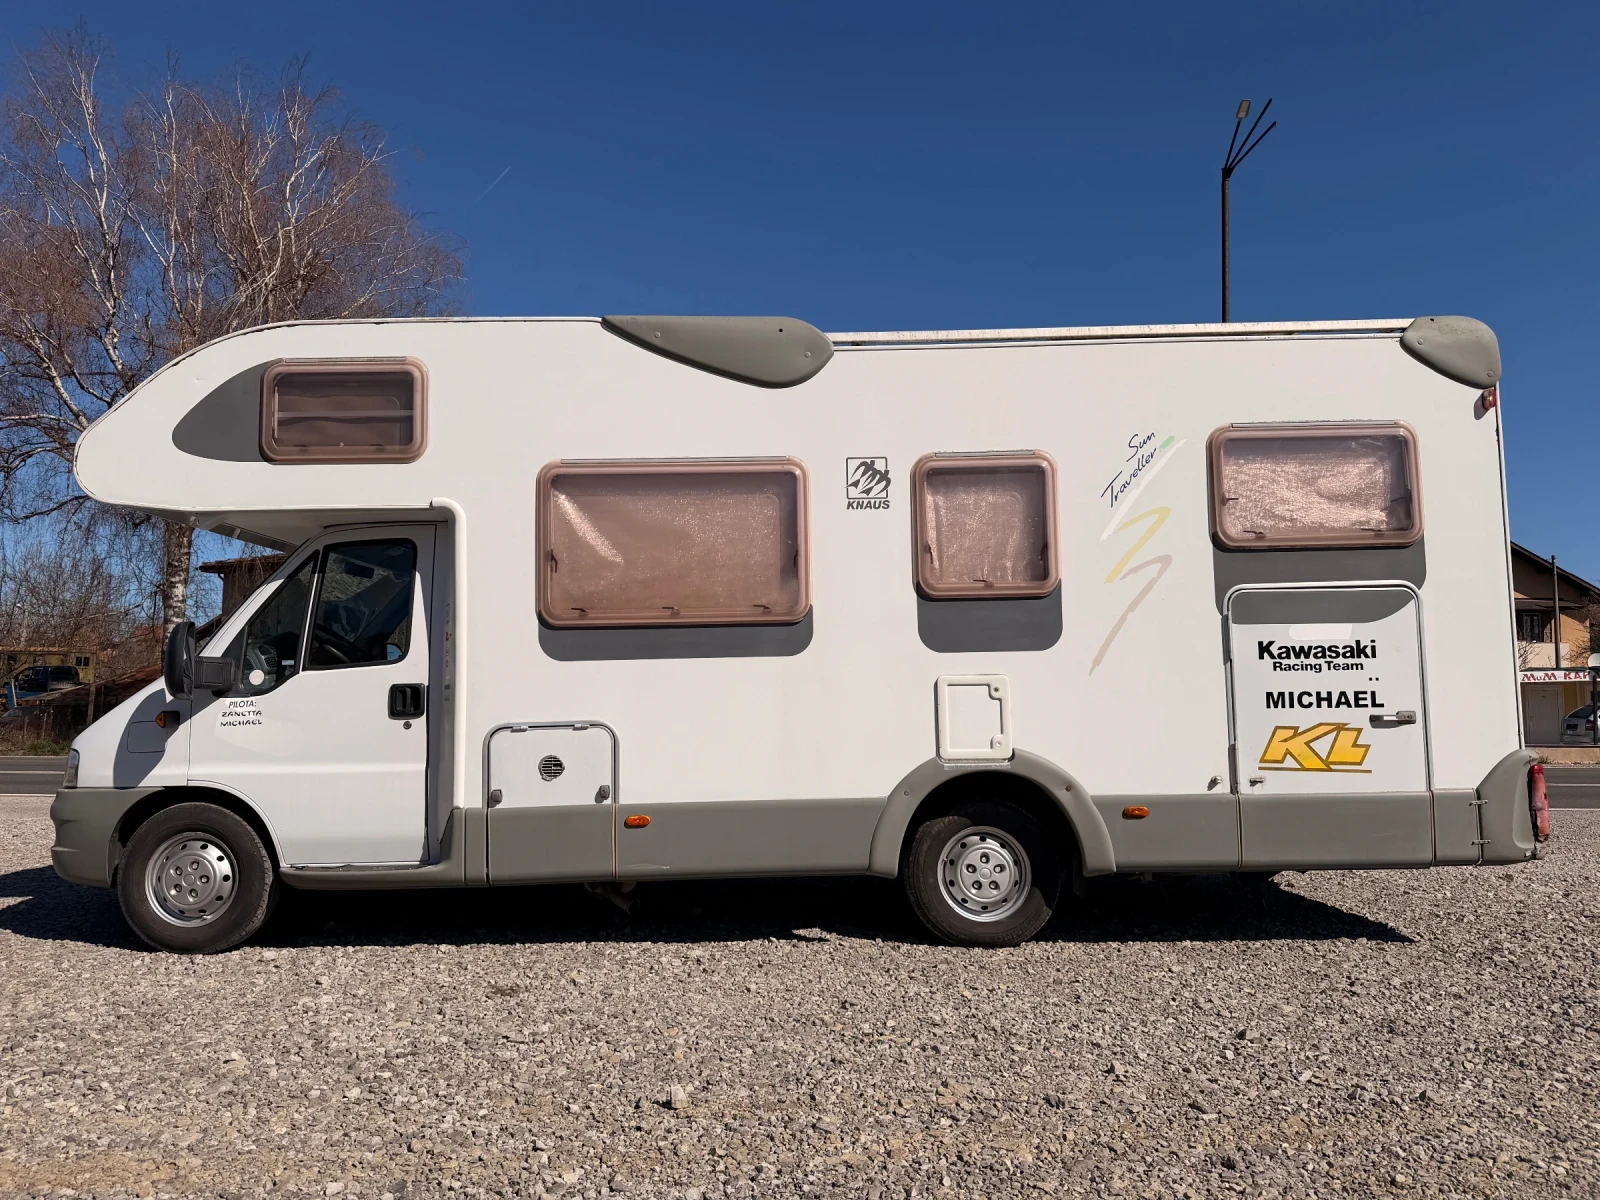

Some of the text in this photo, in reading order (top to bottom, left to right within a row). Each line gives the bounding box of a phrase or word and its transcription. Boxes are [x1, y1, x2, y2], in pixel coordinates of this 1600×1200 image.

[1126, 432, 1156, 462] Sun
[1100, 447, 1157, 508] Traveller
[846, 500, 891, 510] KNAUS
[1257, 639, 1377, 660] Kawasaki
[1272, 661, 1364, 673] Racing Team
[228, 700, 257, 709] PILOTA:
